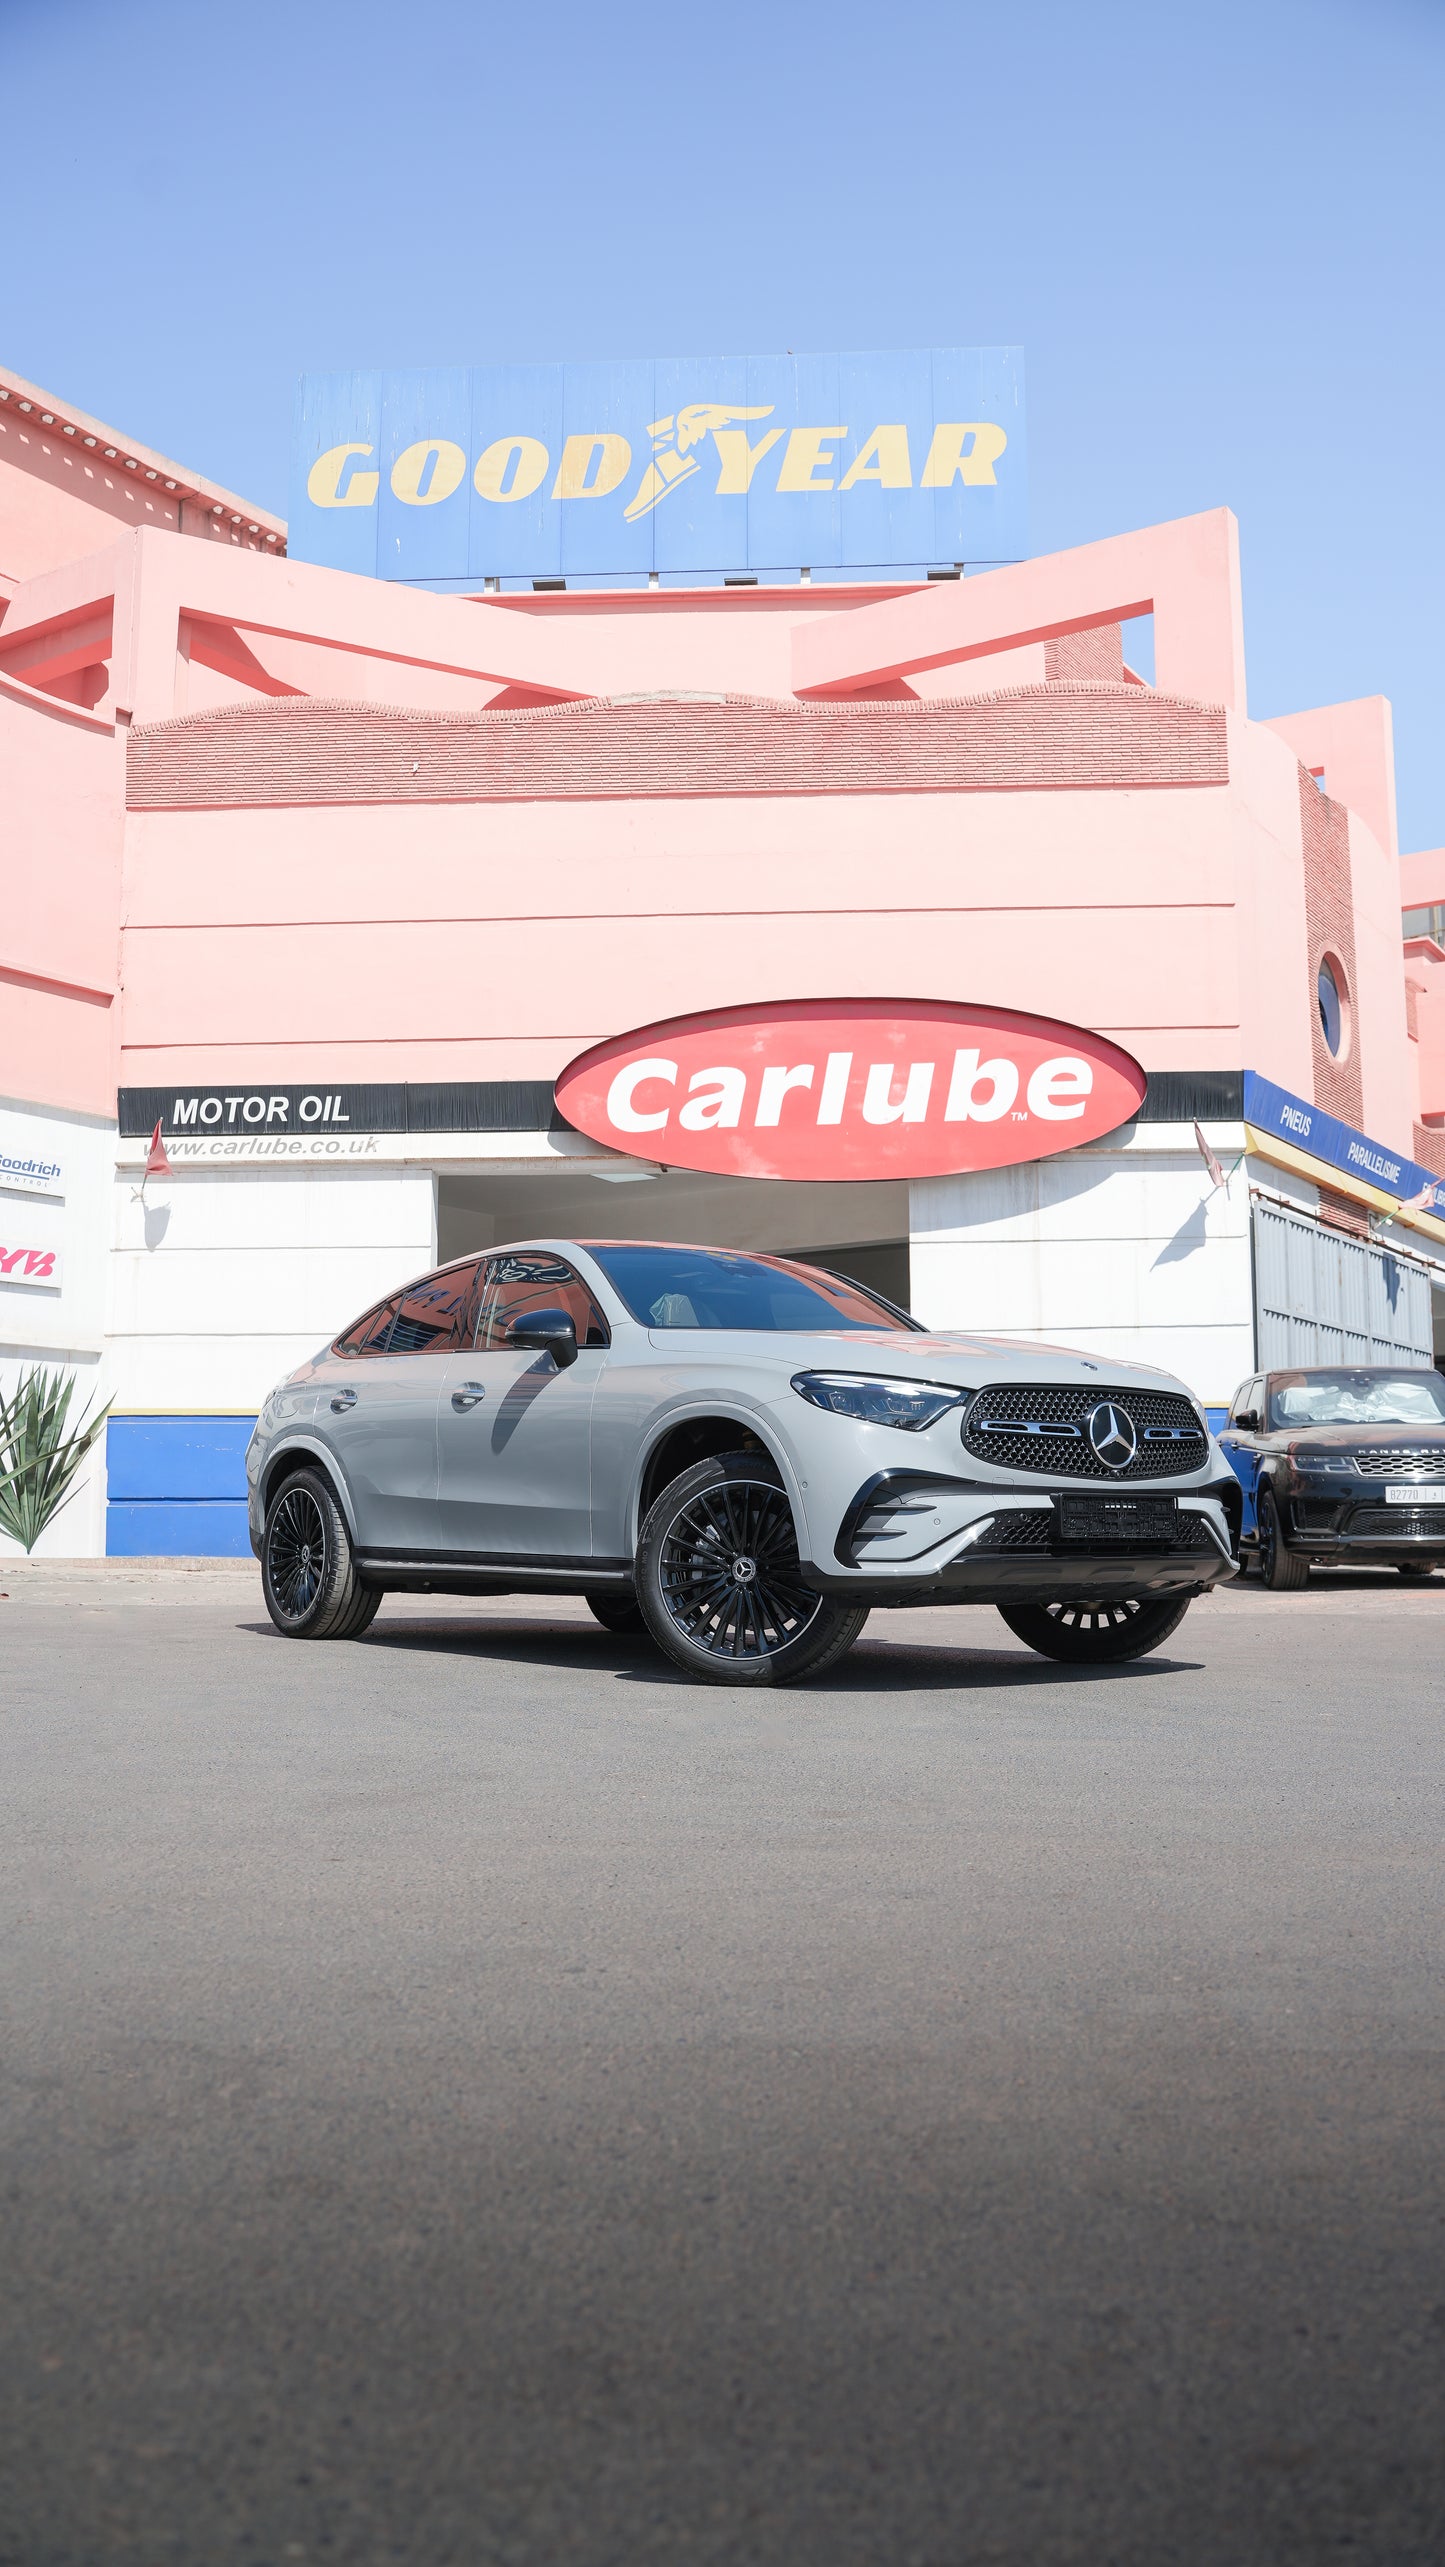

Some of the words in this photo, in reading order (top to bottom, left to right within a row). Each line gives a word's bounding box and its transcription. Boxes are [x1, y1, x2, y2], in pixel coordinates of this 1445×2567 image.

[173, 1096, 290, 1125] MOTOR
[299, 1095, 350, 1122] OIL
[606, 1048, 1094, 1134] Carlube
[1280, 1105, 1312, 1137] PNEUS
[1347, 1142, 1401, 1184] PARALLELISME
[0, 1246, 56, 1277] YB
